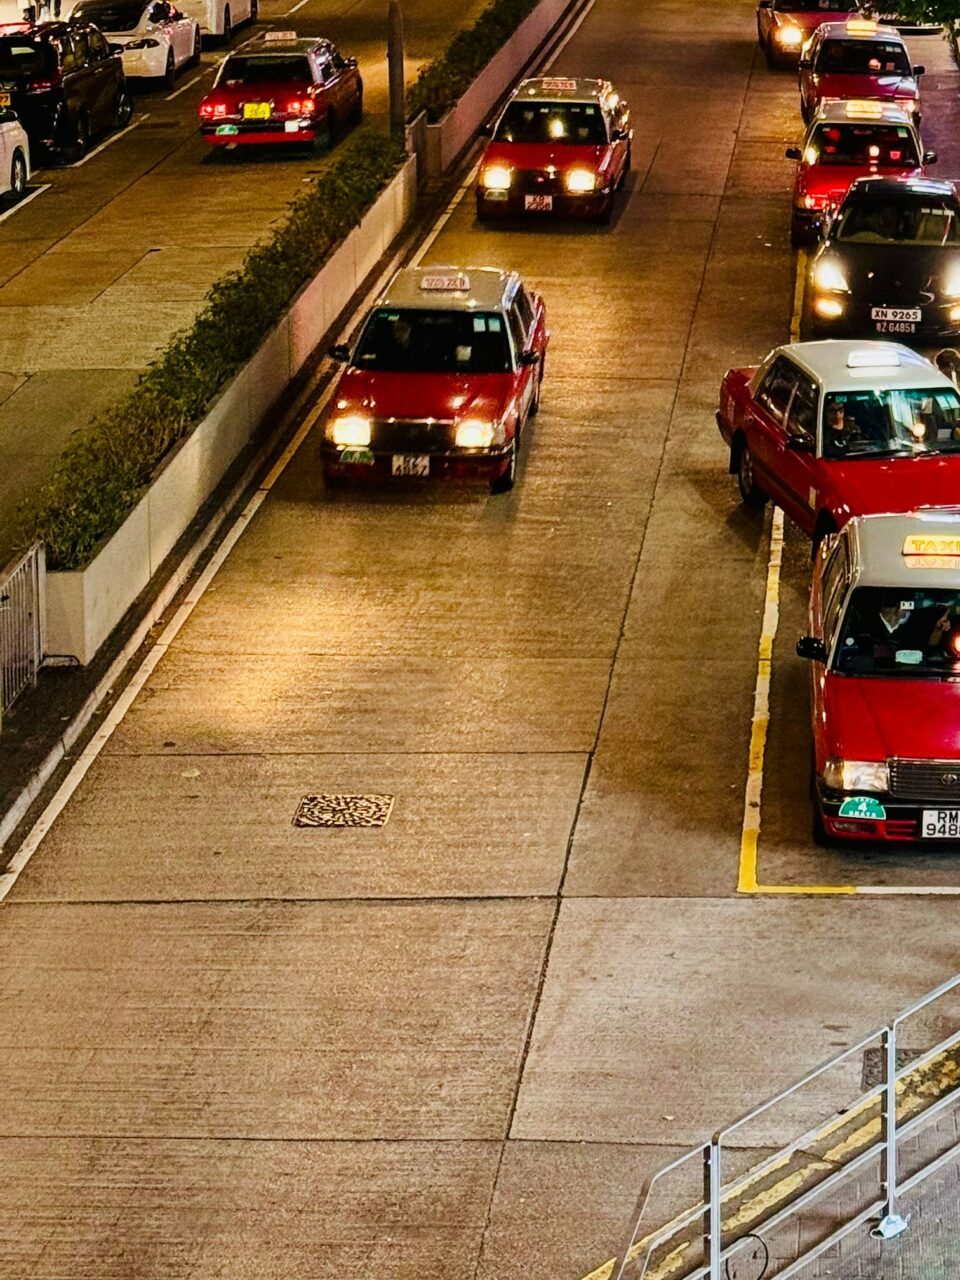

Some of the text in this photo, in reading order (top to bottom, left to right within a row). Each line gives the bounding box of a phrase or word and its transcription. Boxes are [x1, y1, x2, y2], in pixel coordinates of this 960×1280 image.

[874, 310, 919, 320] XN 9265
[857, 801, 868, 812] 4
[937, 811, 959, 824] RM
